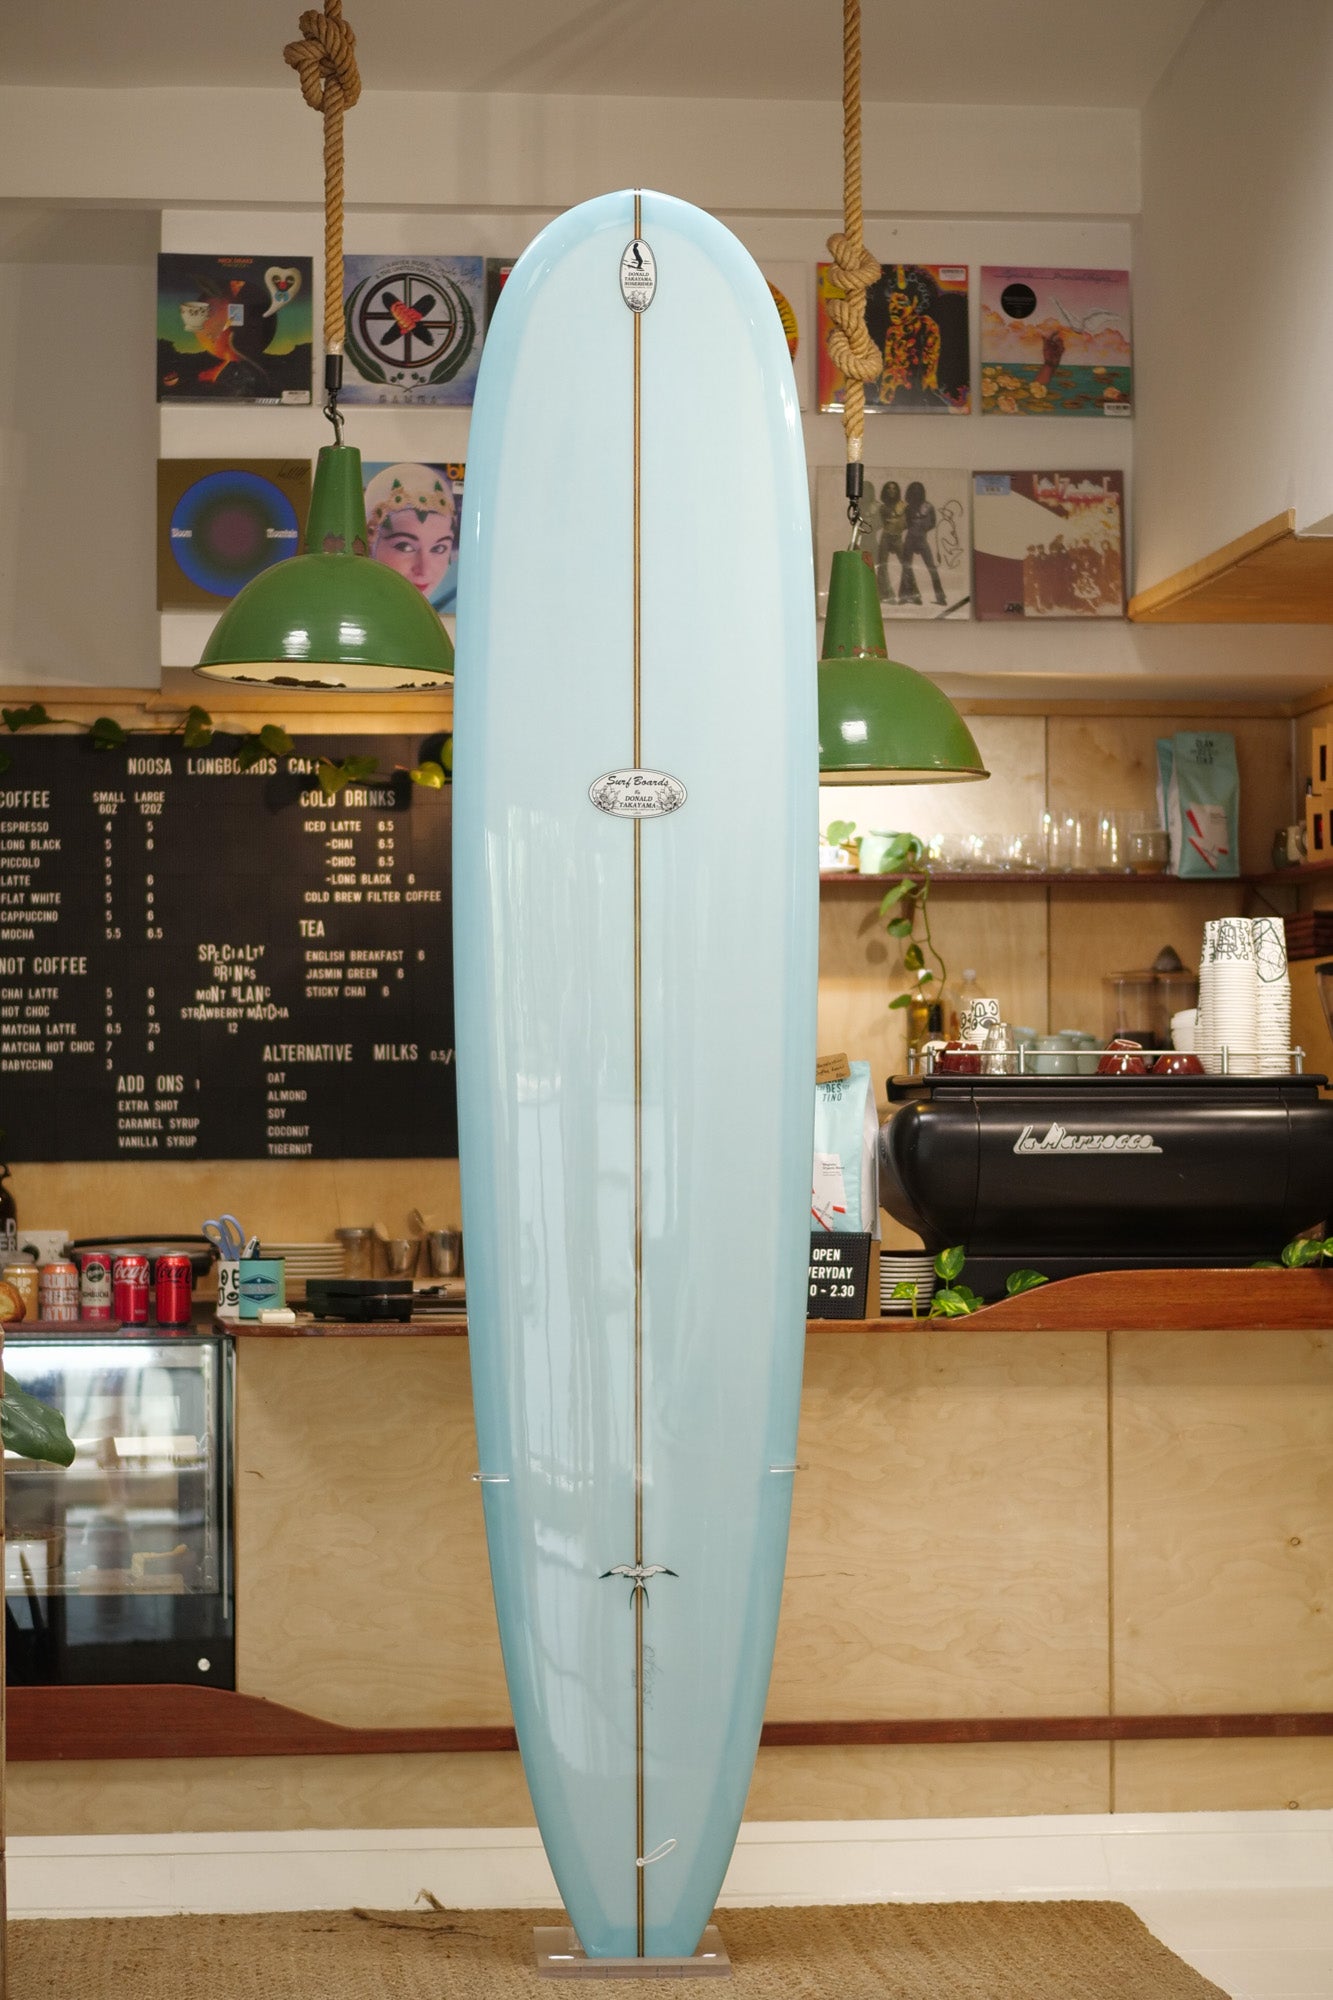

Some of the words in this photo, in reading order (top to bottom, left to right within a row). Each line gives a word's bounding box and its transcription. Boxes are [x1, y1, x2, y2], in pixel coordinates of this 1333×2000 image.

[128, 758, 172, 775] NOOSA
[188, 758, 277, 775] LONGBORDS
[607, 776, 632, 788] Surf
[634, 776, 669, 786] Boards
[0, 791, 49, 808] COFFEE
[93, 792, 126, 803] SMALL
[135, 792, 165, 803] LARGE
[301, 790, 336, 807] COLD
[344, 789, 394, 807] DRINKS
[1, 822, 49, 833] ESPRESSO
[106, 822, 111, 832] 4
[147, 821, 153, 832] 5
[305, 821, 326, 832] ICED
[331, 821, 361, 832] LATTE
[378, 821, 393, 831] 6.5
[1, 839, 25, 850] LONG
[31, 839, 60, 850] BLACK
[105, 839, 111, 850] 5
[147, 839, 153, 850] 6
[378, 838, 394, 849] 6.5
[1, 857, 40, 868] PICCOLO
[105, 857, 111, 867] 5
[378, 856, 394, 867] 6.5
[1, 875, 30, 886] LATTE
[106, 875, 112, 886] 5
[147, 875, 153, 885] 6
[361, 874, 391, 884] BLACK
[408, 874, 415, 884] 6
[1, 893, 24, 904] FLAT
[31, 893, 60, 904] WHITE
[106, 892, 112, 903] 5
[147, 893, 153, 903] 6
[305, 891, 329, 902] COLD
[334, 892, 362, 902] BREW
[367, 891, 400, 902] FILTER
[405, 891, 441, 902] COFFEE
[1, 911, 58, 922] CAPPUCCINO
[106, 910, 112, 921] 5
[147, 910, 154, 921] 6
[1, 929, 34, 940] MOCHA
[106, 928, 121, 939] 5.5
[147, 928, 163, 939] 6.5
[300, 920, 324, 937] TEA
[199, 944, 264, 963] SPECIALTY
[306, 951, 345, 961] ENGLISH
[350, 950, 403, 961] BREAKFAST
[418, 950, 425, 961] 6
[0, 957, 25, 974] NOT
[34, 957, 87, 974] COFFEE
[214, 965, 256, 981] DRINKS
[306, 969, 342, 979] JASMIN
[347, 968, 377, 979] GREEN
[397, 968, 404, 979] 6
[2, 988, 23, 999] CHAI
[29, 988, 58, 999] LATTE
[106, 987, 112, 999] 5
[148, 987, 154, 998] 6
[196, 986, 226, 1003] MONT
[232, 986, 271, 1003] BLANC
[306, 986, 339, 997] STICKY
[344, 986, 366, 996] CHAI
[382, 986, 389, 997] 6
[2, 1006, 19, 1017] HOT
[26, 1006, 49, 1017] CHOC
[106, 1005, 112, 1016] 5
[148, 1005, 155, 1016] 6
[181, 1004, 244, 1021] STRAWBERRY
[2, 1024, 41, 1035] MATCHA
[47, 1023, 76, 1035] LATTE
[106, 1023, 121, 1034] 6.5
[228, 1023, 238, 1033] 12
[2, 1042, 41, 1053] MATCHA
[46, 1041, 64, 1053] HOT
[70, 1041, 94, 1052] CHOC
[107, 1041, 112, 1052] 7
[263, 1044, 352, 1062] ALTERNATIVE
[374, 1044, 417, 1061] MILKS
[2, 1060, 53, 1071] BABYCCINO
[107, 1059, 112, 1070] 3
[118, 1075, 144, 1092] ADD
[157, 1075, 183, 1092] ONS
[268, 1072, 285, 1083] OAT
[268, 1090, 307, 1101] ALMOND
[119, 1100, 149, 1111] EXTRA
[155, 1100, 178, 1111] SHOT
[268, 1108, 286, 1119] SOY
[119, 1118, 163, 1129] CARAMEL
[170, 1118, 199, 1129] SYRUP
[268, 1126, 309, 1137] COCONUT
[119, 1136, 158, 1147] VANILLA
[167, 1136, 197, 1147] SYRUP
[268, 1143, 312, 1154] TIGERNUT
[813, 1249, 840, 1261] OPEN
[808, 1267, 853, 1279] ERYDAY
[830, 1285, 854, 1297] 2.30
